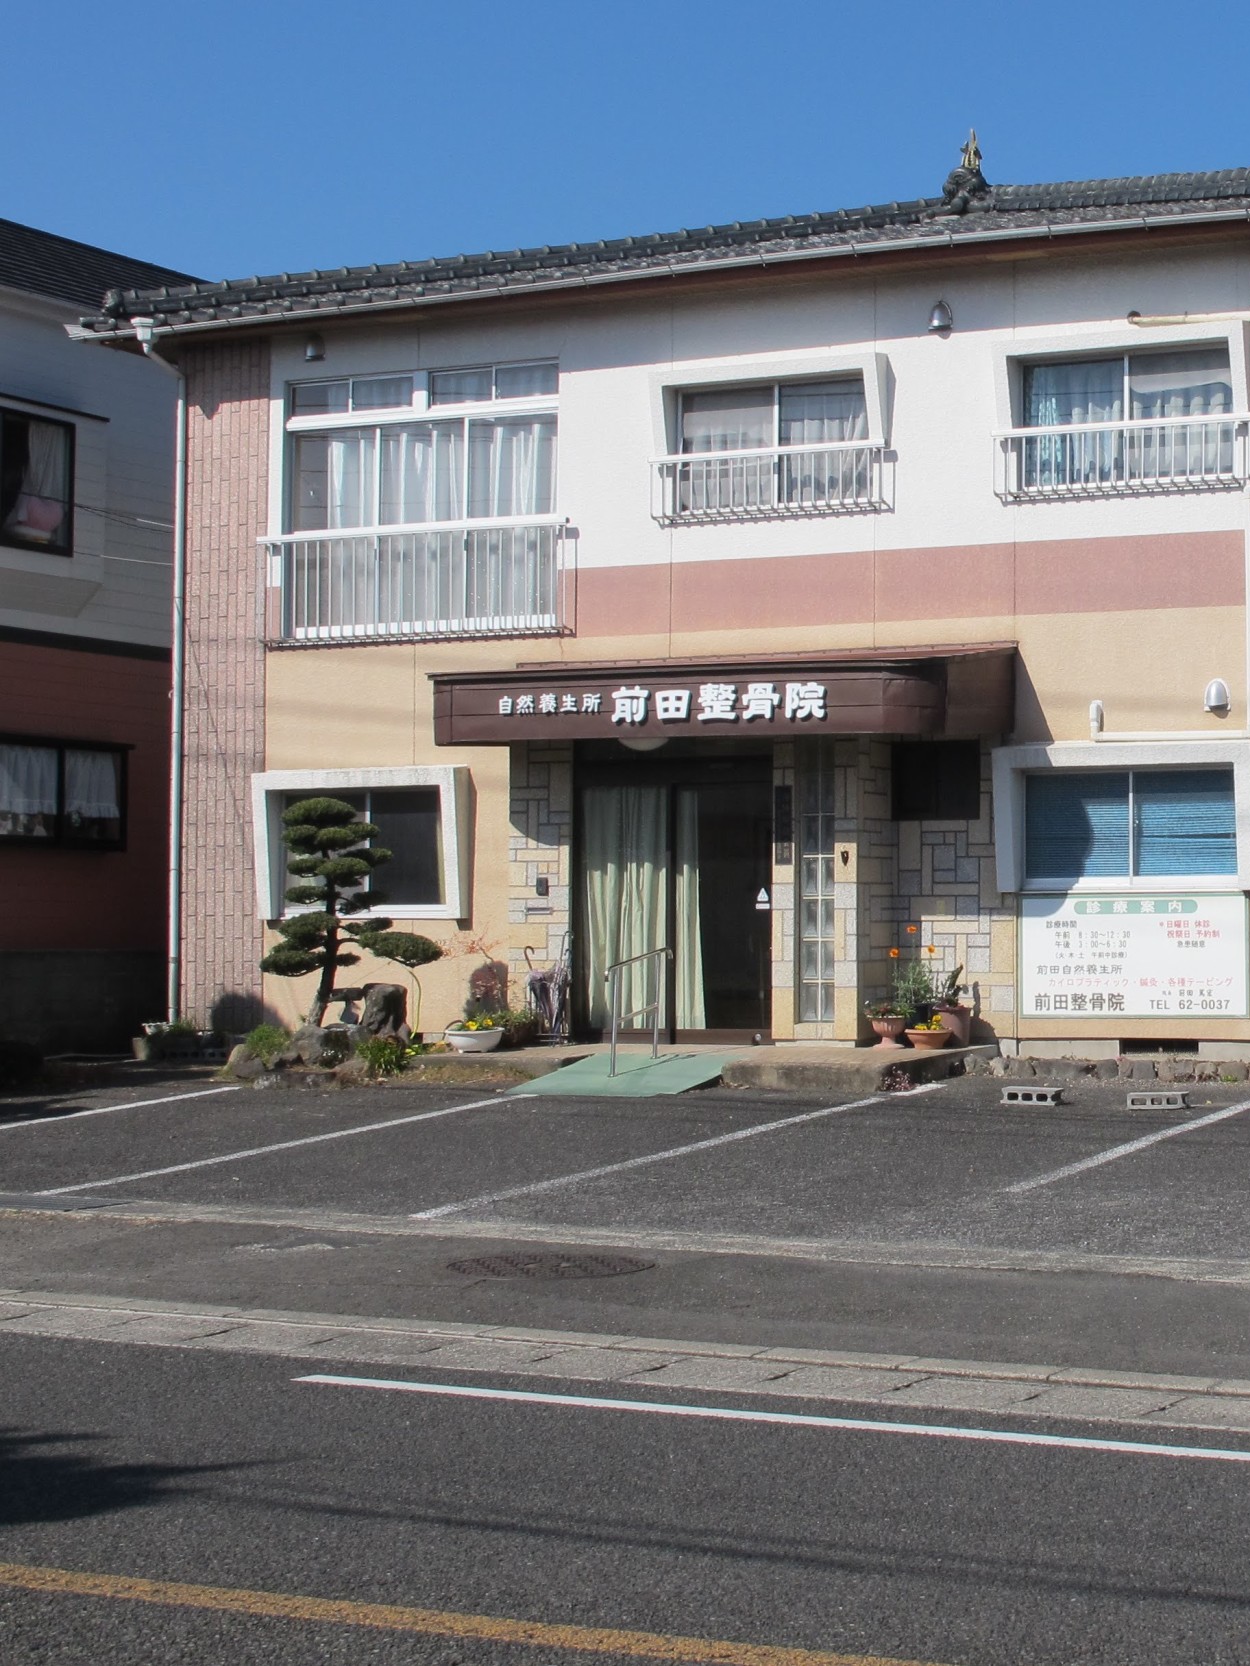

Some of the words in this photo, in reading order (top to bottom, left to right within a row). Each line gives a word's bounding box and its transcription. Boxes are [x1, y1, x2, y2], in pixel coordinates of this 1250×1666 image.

[498, 692, 602, 715] 自然養生所
[611, 682, 828, 724] 前田整骨院
[1086, 900, 1182, 914] 診療案内
[1045, 920, 1077, 929] 診療時間
[1055, 931, 1071, 940] 午前
[1196, 929, 1221, 939] 予約制
[1055, 940, 1071, 949] 午後
[1037, 964, 1123, 976] 前田自然養生所
[1034, 993, 1126, 1012] 前田整骨院
[1149, 999, 1170, 1010] TEL
[1178, 999, 1231, 1010] 62-0037
